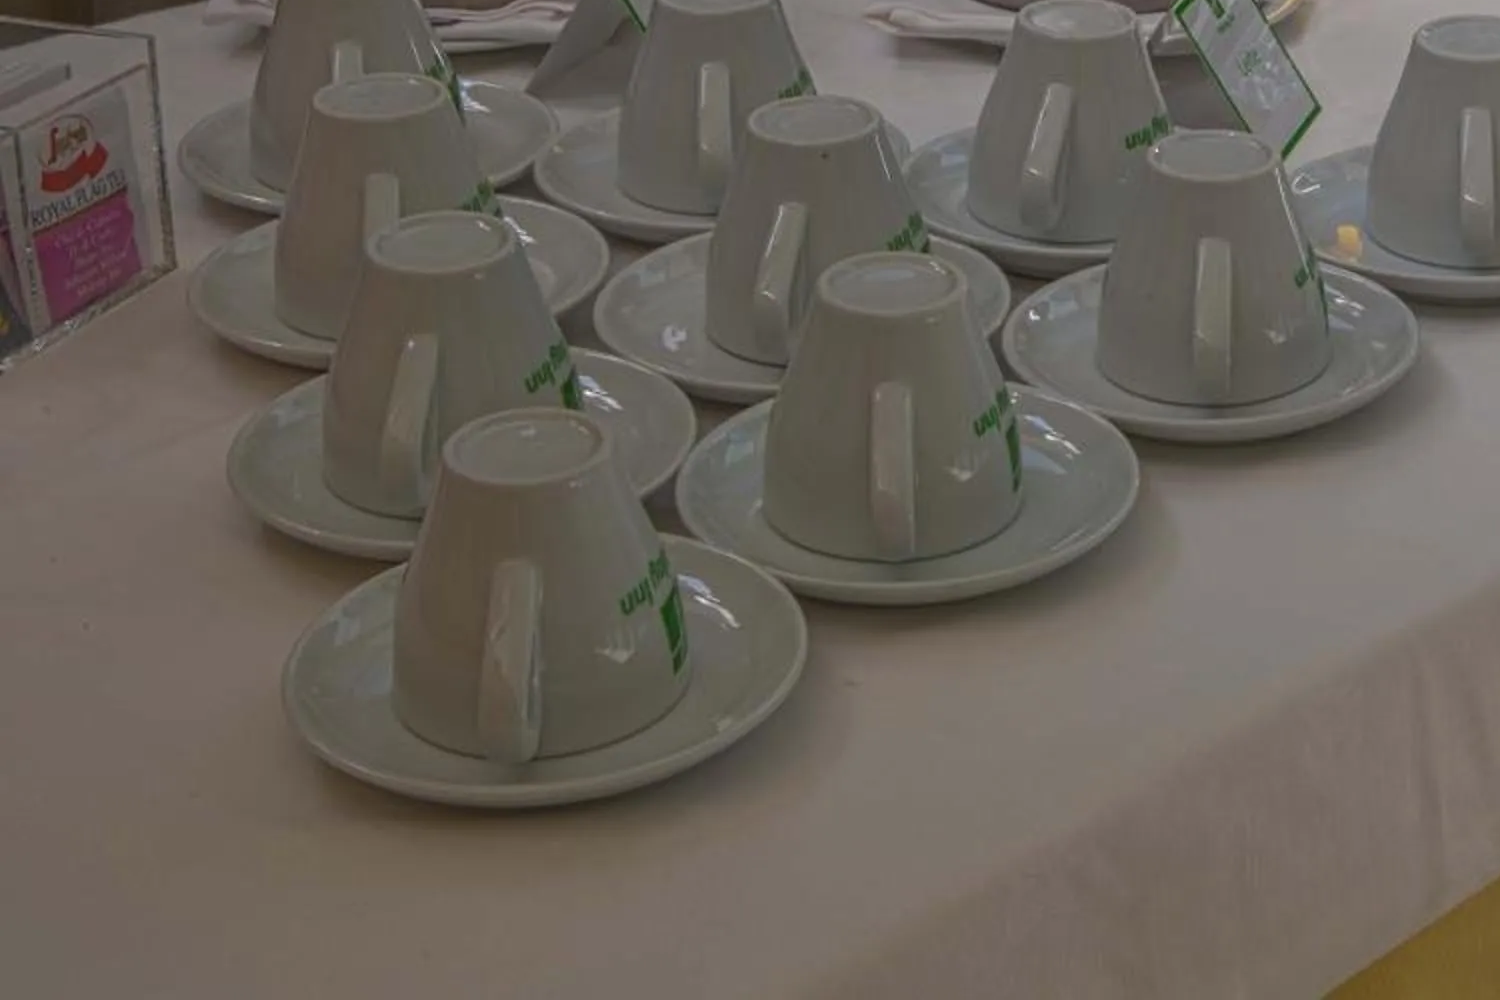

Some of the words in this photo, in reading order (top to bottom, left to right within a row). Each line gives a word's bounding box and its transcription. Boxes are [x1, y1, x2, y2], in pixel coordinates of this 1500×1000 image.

[1125, 128, 1154, 151] Inn
[31, 196, 73, 228] ROYAL
[524, 360, 556, 394] Inn
[973, 407, 1001, 438] Inn
[620, 577, 654, 616] Inn
